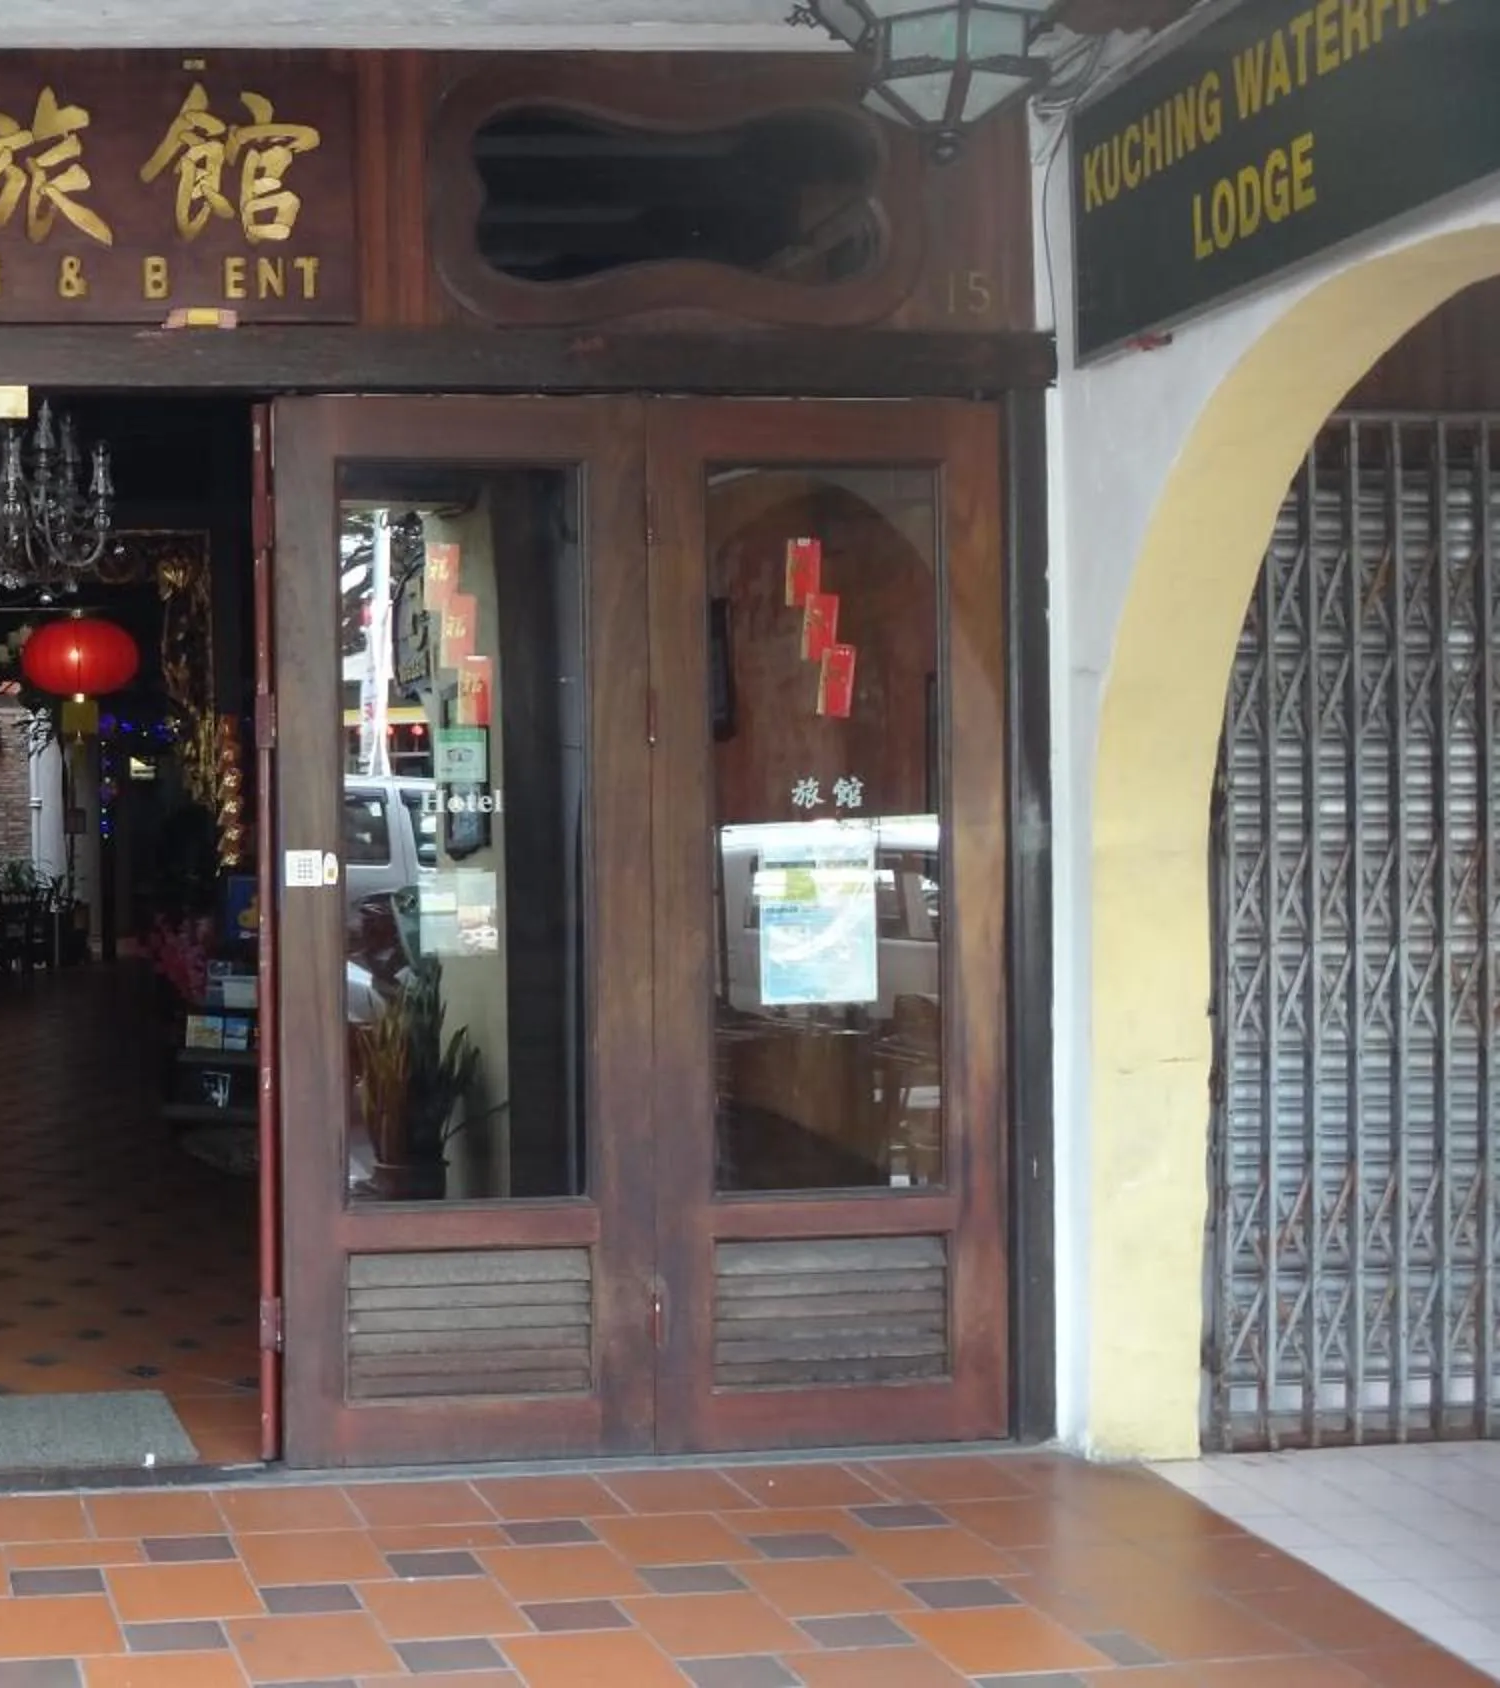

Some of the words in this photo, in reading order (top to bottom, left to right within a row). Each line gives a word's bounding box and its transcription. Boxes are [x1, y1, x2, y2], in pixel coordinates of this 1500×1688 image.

[1082, 71, 1222, 213] KUCHING
[1192, 131, 1317, 260] LODGE
[57, 257, 88, 298] &
[144, 256, 169, 299] B
[224, 256, 321, 298] ENT
[947, 270, 991, 313] 15
[420, 788, 504, 813] Hotel
[791, 776, 865, 809] 旅館
